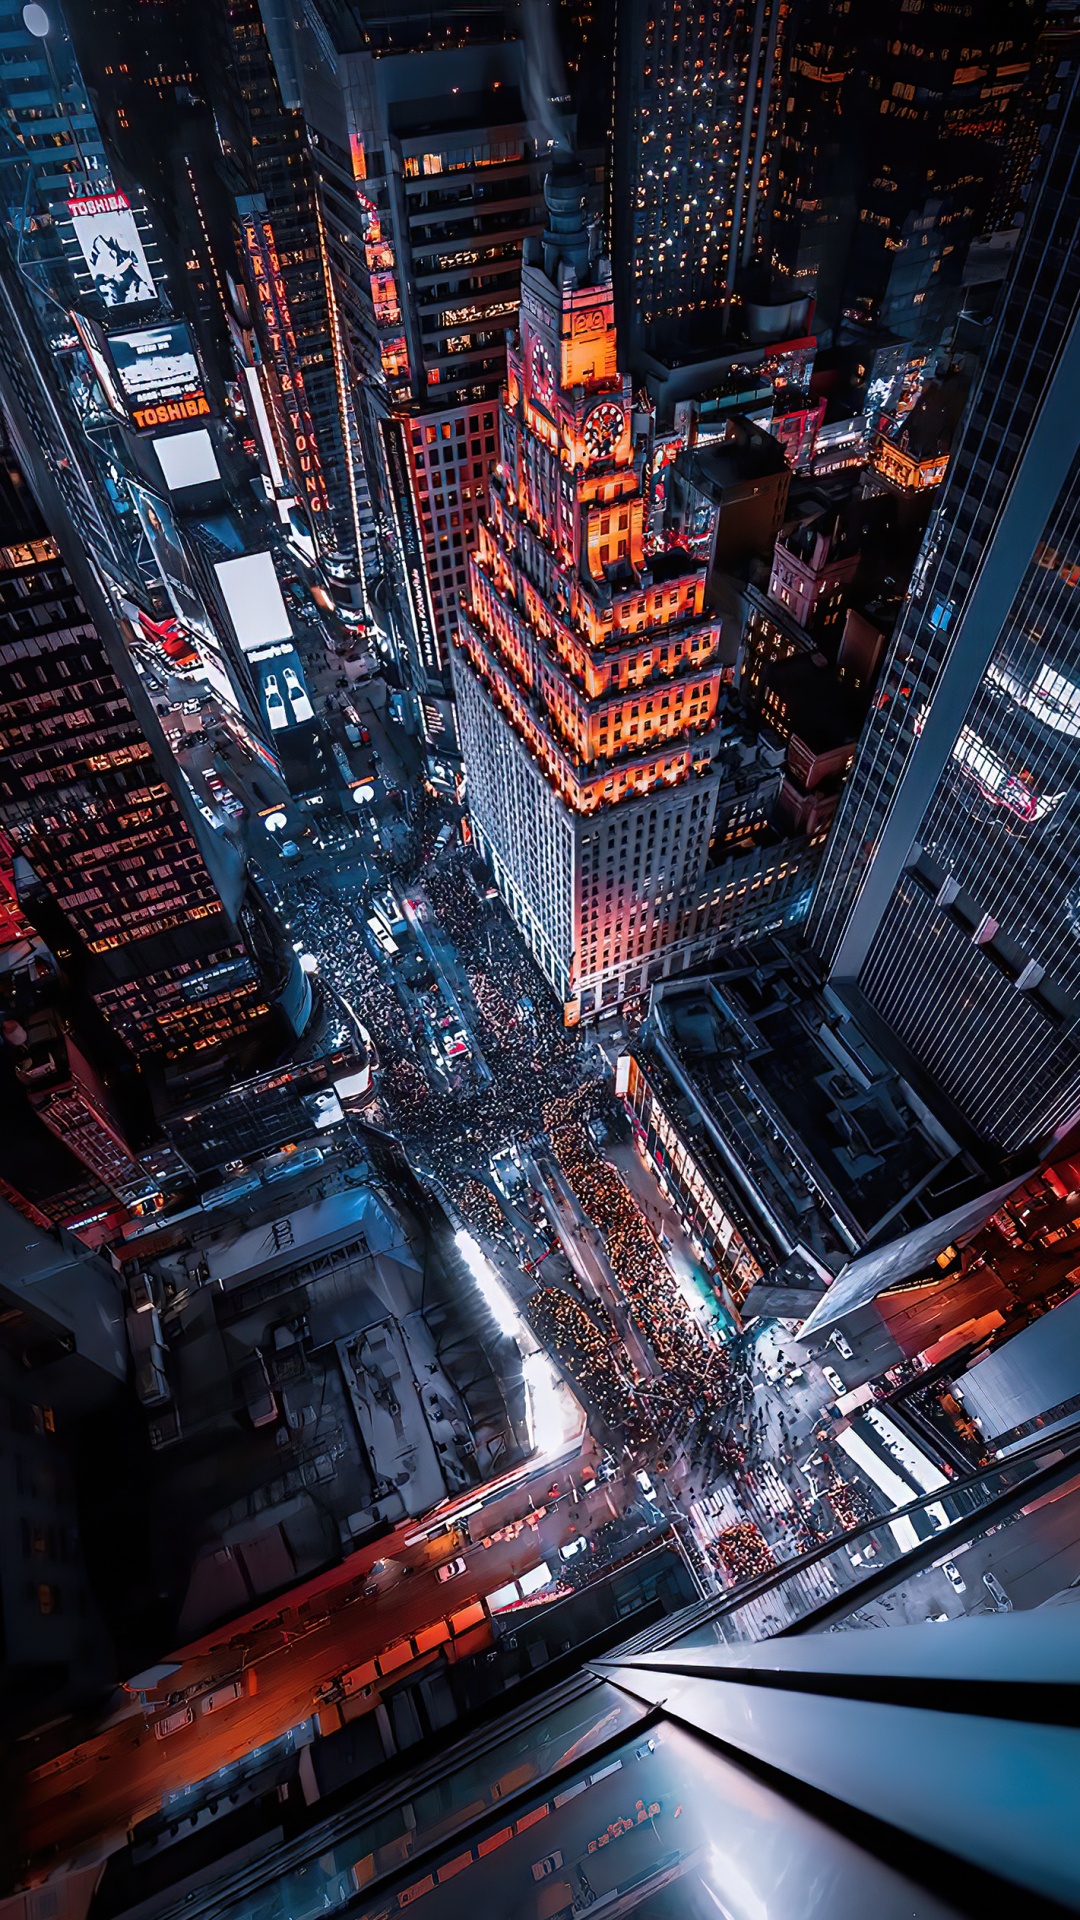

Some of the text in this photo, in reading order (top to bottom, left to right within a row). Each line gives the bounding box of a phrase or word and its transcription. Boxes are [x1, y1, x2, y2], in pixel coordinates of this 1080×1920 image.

[68, 195, 128, 217] TOSHIBA
[246, 226, 281, 351] ERNST
[290, 412, 321, 512] YOUNG
[133, 397, 210, 427] TOSHIBA
